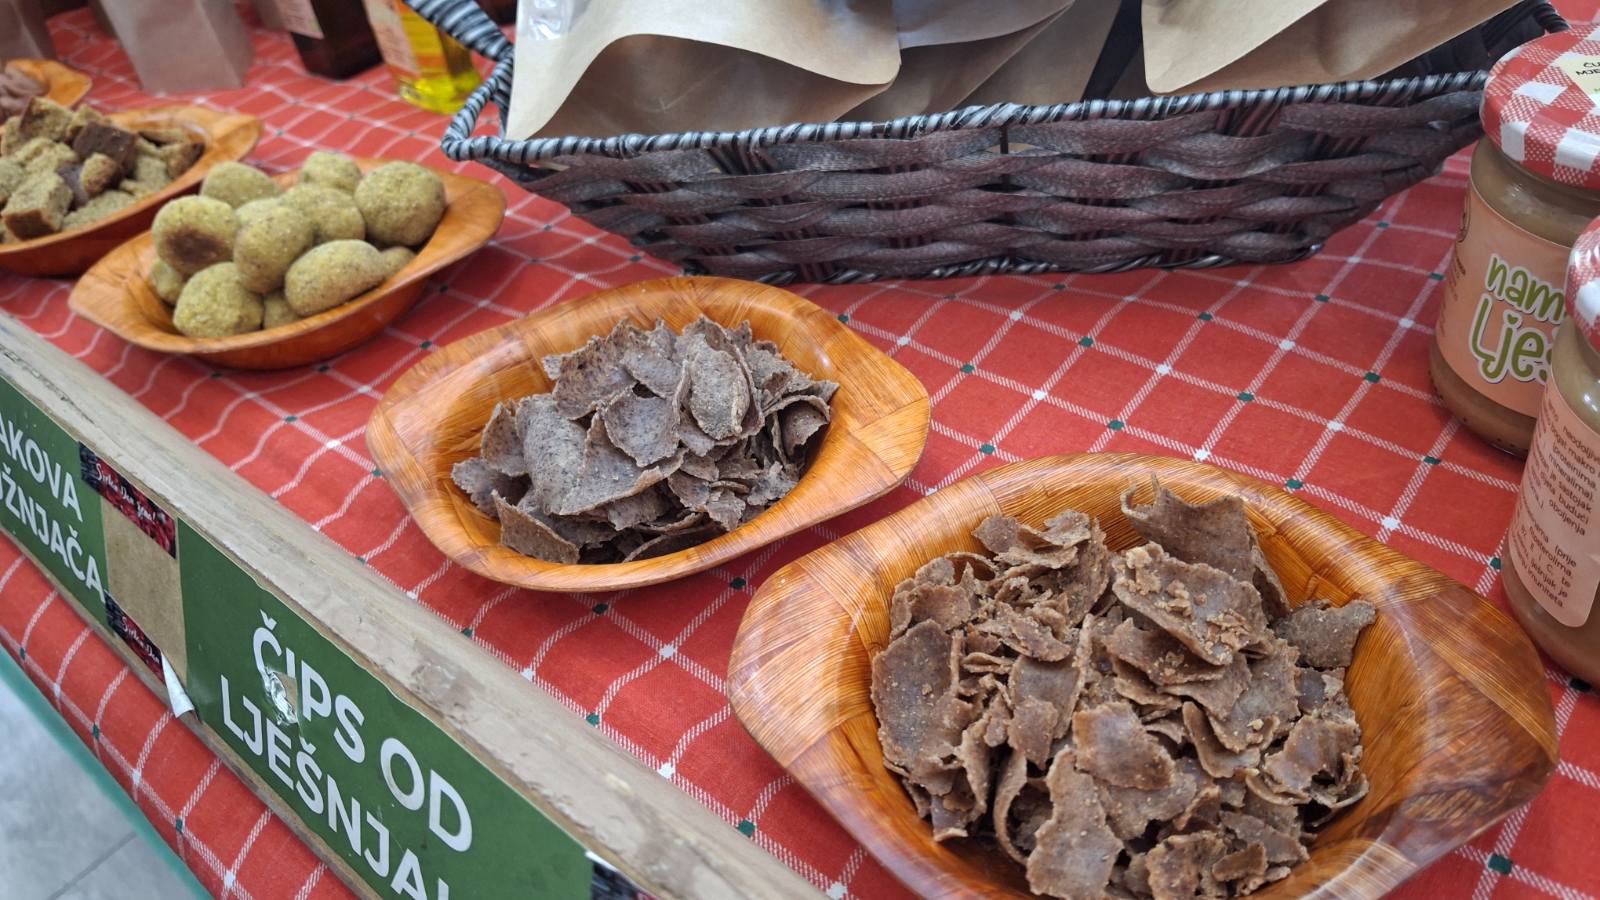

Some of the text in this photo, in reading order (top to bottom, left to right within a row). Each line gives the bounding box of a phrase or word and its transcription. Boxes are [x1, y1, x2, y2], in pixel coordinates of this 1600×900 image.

[1486, 256, 1567, 321] nam
[1471, 297, 1553, 382] Lje
[0, 462, 105, 603] ŽNJAČA
[380, 737, 473, 853] OD
